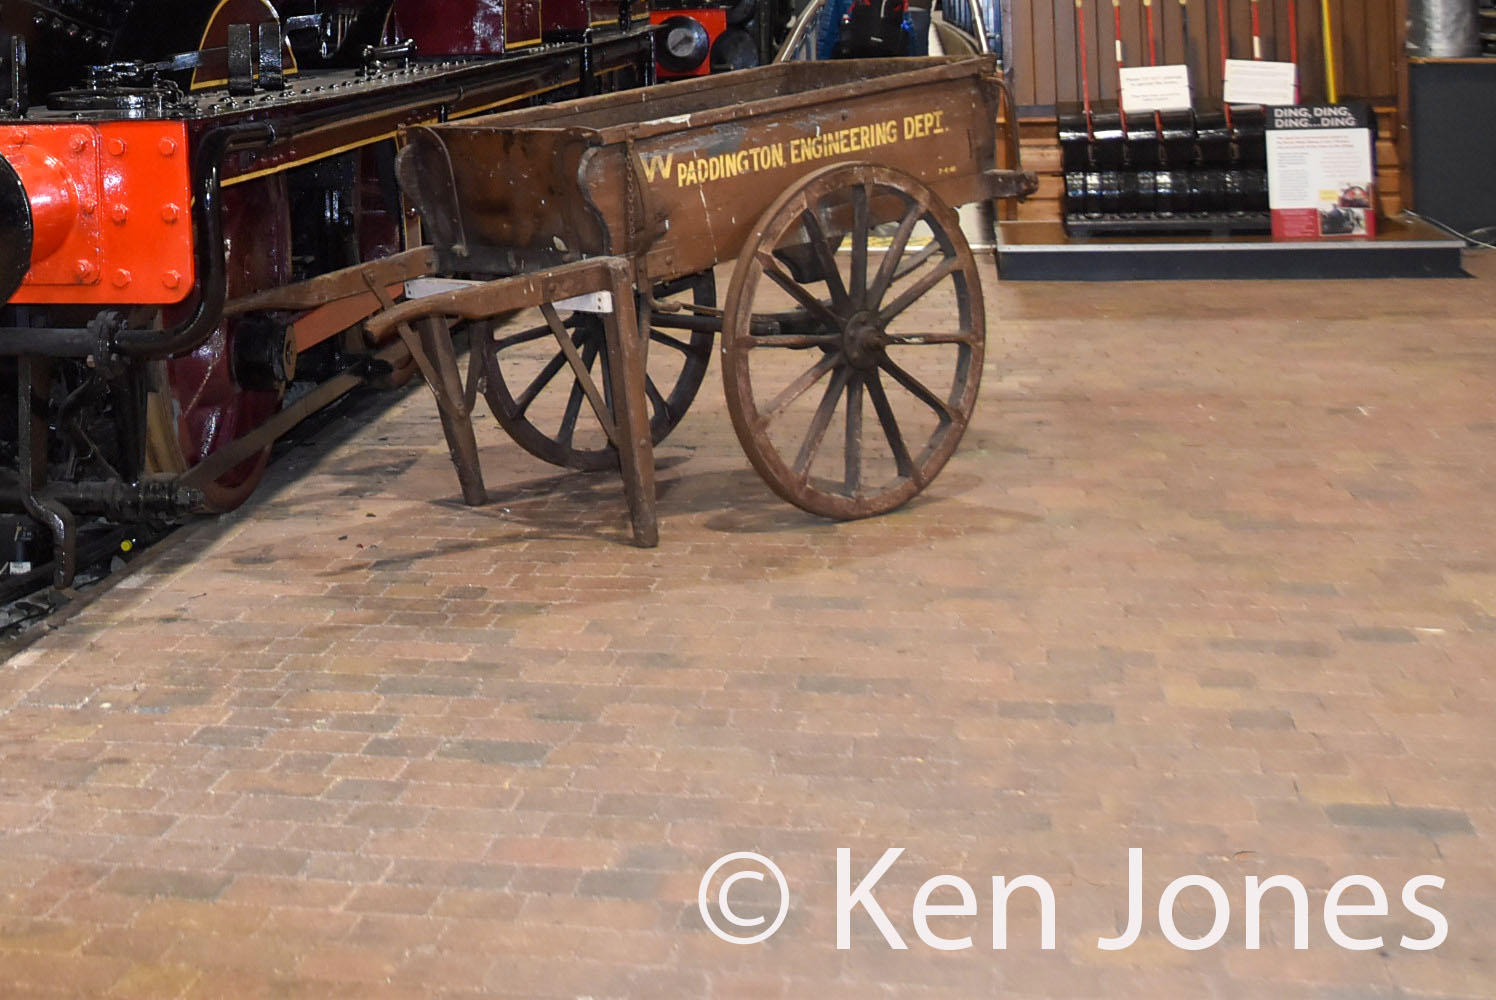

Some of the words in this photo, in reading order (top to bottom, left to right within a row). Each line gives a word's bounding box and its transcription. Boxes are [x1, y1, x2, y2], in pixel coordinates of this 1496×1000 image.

[1273, 107, 1312, 119] DING,
[1313, 106, 1353, 117] DING,
[789, 119, 898, 164] ENGINEERING
